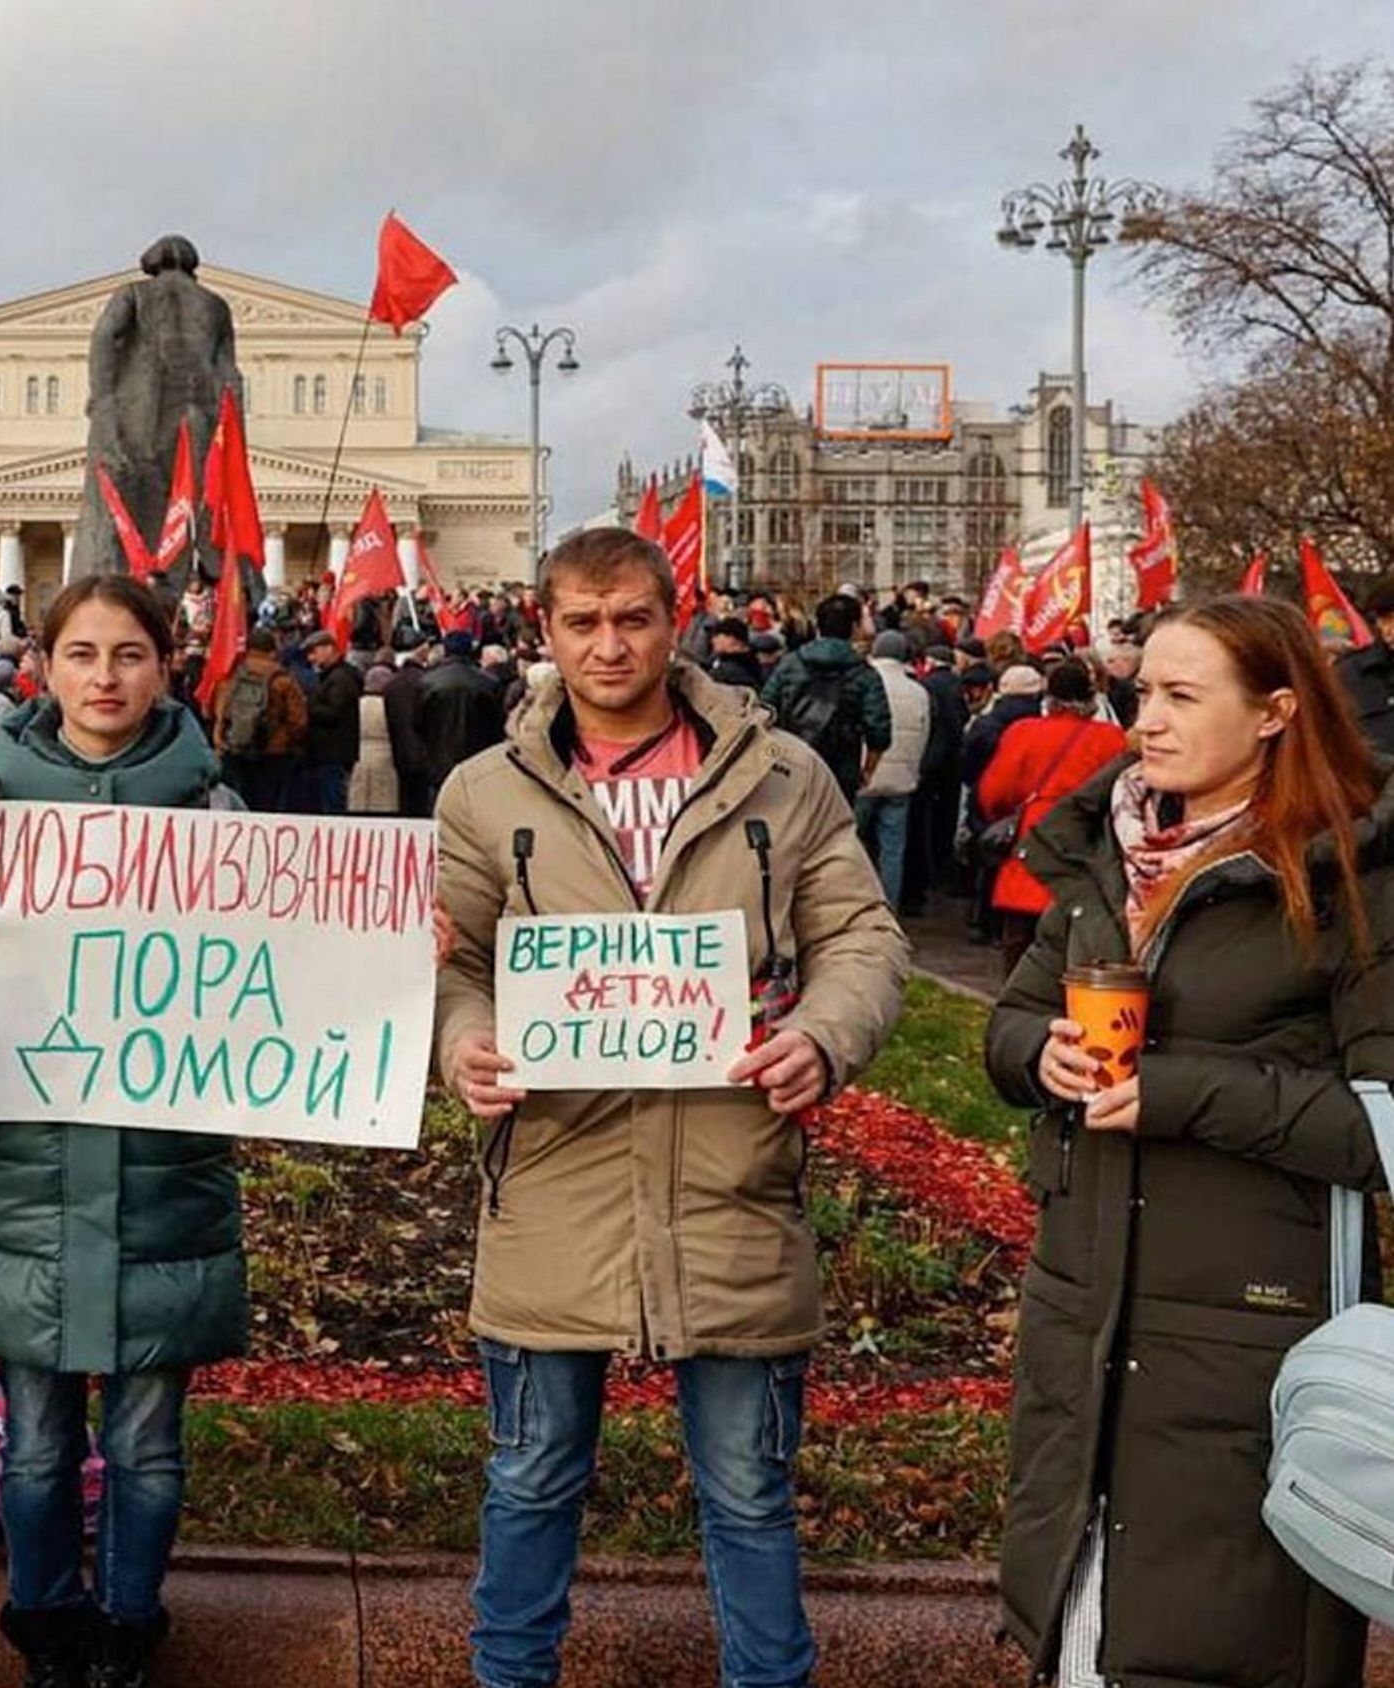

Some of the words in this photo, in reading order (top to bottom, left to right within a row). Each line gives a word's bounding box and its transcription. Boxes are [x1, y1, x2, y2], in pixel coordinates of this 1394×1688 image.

[509, 920, 724, 973] ВЕРНИТЕ
[68, 930, 284, 1028] ПОРА
[564, 969, 714, 1012] ДЕТЯМ
